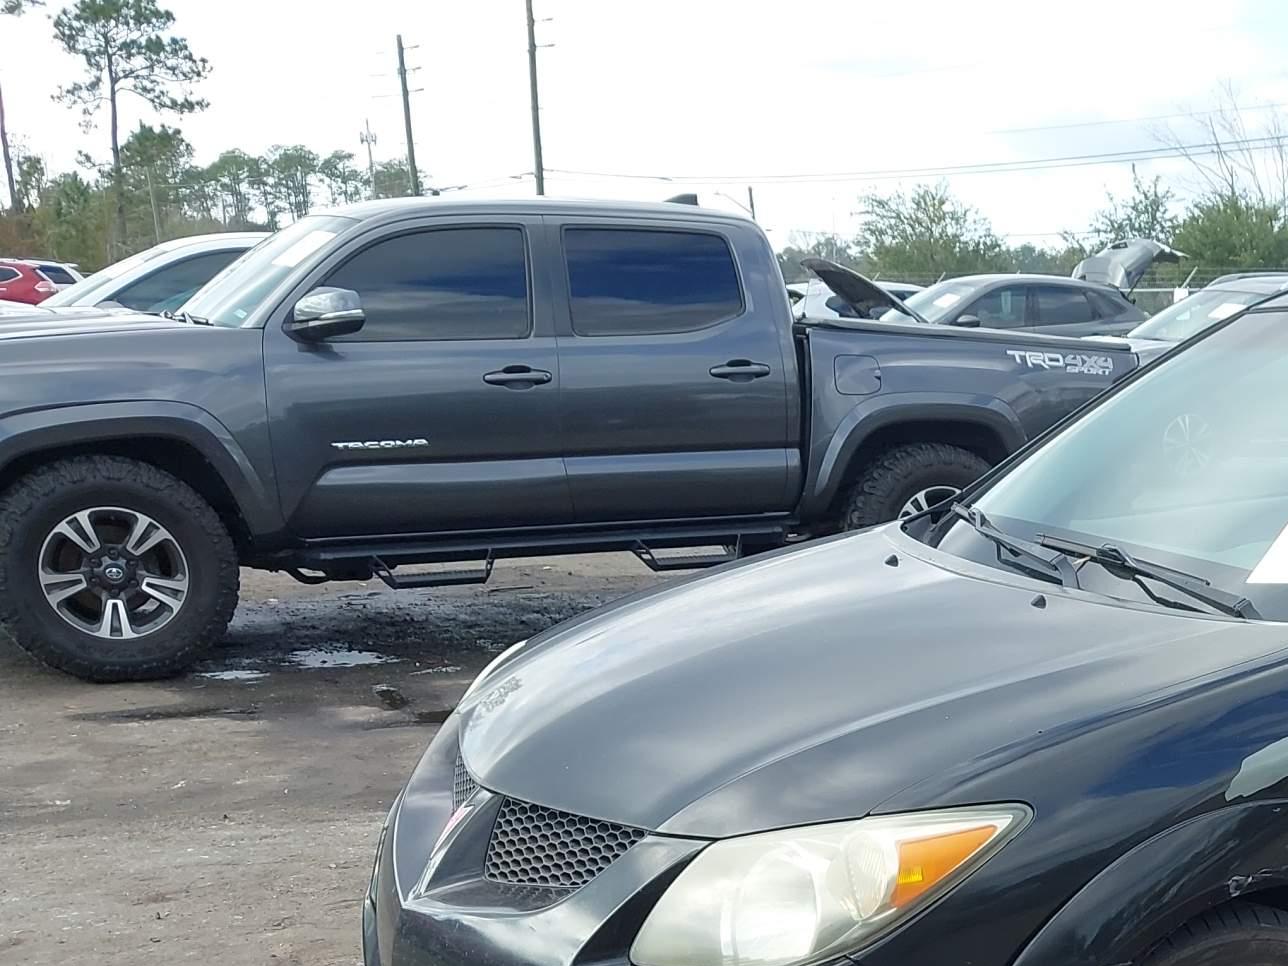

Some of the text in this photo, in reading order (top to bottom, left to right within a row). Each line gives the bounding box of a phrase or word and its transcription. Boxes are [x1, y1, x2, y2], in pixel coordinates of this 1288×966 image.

[1006, 349, 1065, 369] TRD
[1066, 365, 1113, 375] SPORT
[331, 439, 428, 449] TACOMA
